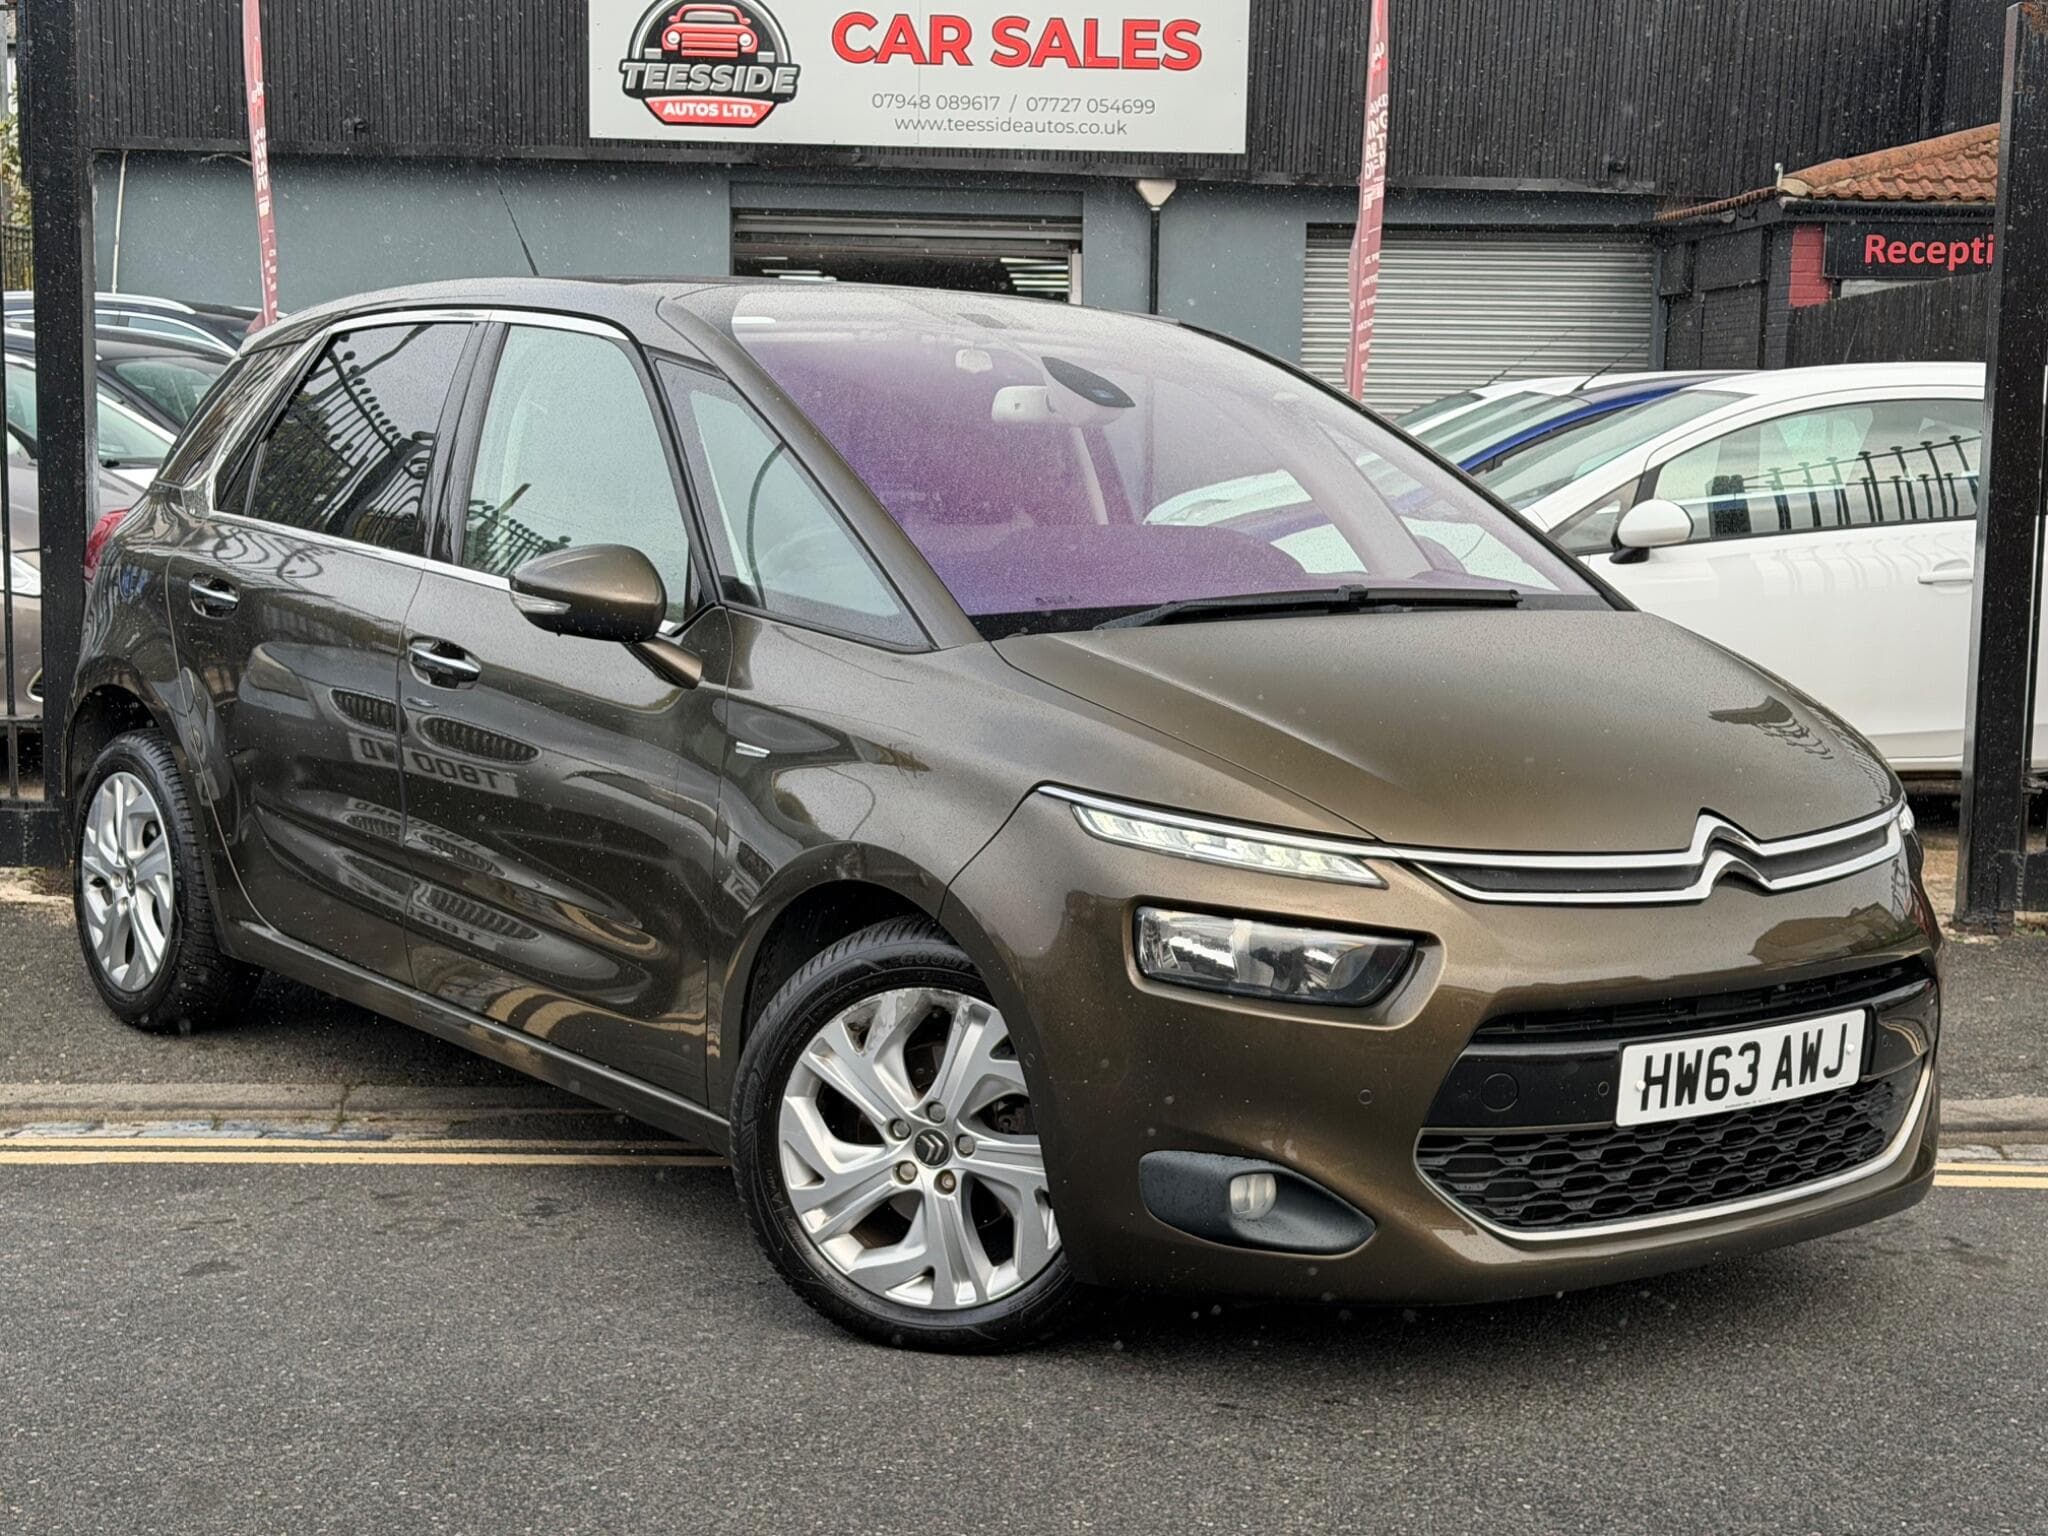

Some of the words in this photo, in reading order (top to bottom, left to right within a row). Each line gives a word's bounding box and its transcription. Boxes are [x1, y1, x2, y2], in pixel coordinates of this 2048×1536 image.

[831, 11, 974, 66] CAR
[990, 15, 1203, 71] SALES
[621, 62, 798, 94] TEESSIDE
[663, 102, 719, 117] AUTOS
[722, 104, 757, 118] LTD.
[871, 93, 931, 110] 07948
[936, 94, 1000, 111] 089617
[1026, 96, 1082, 113] 07727
[1086, 98, 1156, 114] 054699
[894, 117, 1128, 135] www.teessideautos.co.uk
[1640, 1041, 1761, 1112] HW63
[1771, 1023, 1848, 1091] AWJ
